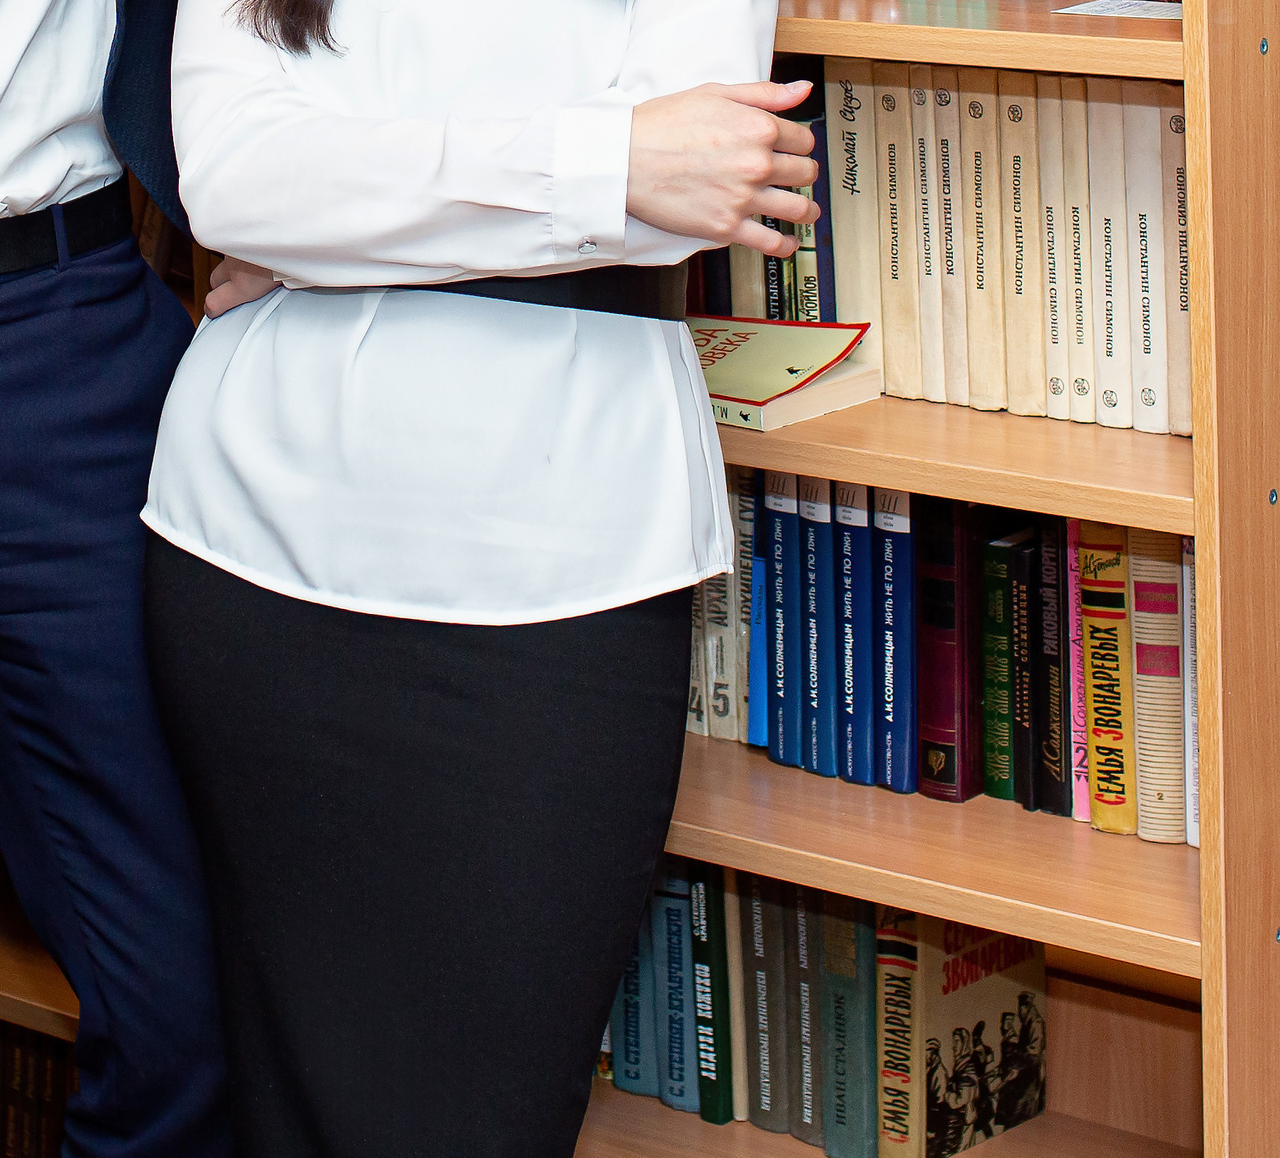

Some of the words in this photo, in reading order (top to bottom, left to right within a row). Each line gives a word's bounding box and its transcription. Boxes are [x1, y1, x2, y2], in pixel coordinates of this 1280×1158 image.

[839, 79, 861, 122] Сизов
[841, 131, 860, 195] Николай
[887, 143, 897, 200] СИМОНОВ
[941, 139, 951, 194] СИМОНОВ
[1012, 155, 1022, 213] СИМОНОВ
[1176, 167, 1187, 226] СИМОНОВ
[889, 203, 898, 280] КОНСТАНТИН
[944, 198, 954, 275] КОНСТАНТИН
[1014, 216, 1023, 295] КОНСТАНТИН
[1046, 206, 1055, 284] КОНСТАНТИН
[1103, 218, 1112, 297] КОНСТАНТИН
[1177, 230, 1189, 311] КОНСТАНТИН
[1048, 287, 1058, 345] СИМОНОВ
[1105, 300, 1114, 358] СИМОНОВ
[774, 518, 782, 541] ЛЖИ
[775, 544, 782, 559] ПО
[843, 532, 851, 556] ЛЖИ
[884, 539, 893, 563] ЛЖИ
[774, 577, 783, 603] ЖИТЬ
[775, 562, 782, 575] НЕ
[844, 558, 851, 573] ПО
[844, 575, 851, 588] НЕ
[884, 565, 892, 581] ПО
[885, 583, 892, 595] НЕ
[844, 591, 852, 618] ЖИТЬ
[884, 598, 893, 625] ЖИТЬ
[1040, 588, 1058, 655] РАКОВЫЙ
[711, 683, 729, 717] 5
[1089, 625, 1124, 741] ЗВОНАРЕВЫХ
[1094, 746, 1126, 806] СЕМЬЯ
[1156, 792, 1164, 801] 2
[695, 963, 712, 1018] КОЖУХОВ
[757, 971, 768, 1031] ИЗБРАННЫЕ
[697, 1026, 717, 1080] АНДРЕЙ
[881, 973, 912, 1083] ЗВОНАРЕВЫХ
[759, 1034, 771, 1111] ПРОИЗВЕДЕНИЯ
[835, 1080, 846, 1125] ИВАН
[881, 1086, 910, 1143] СЕМЬЯ
